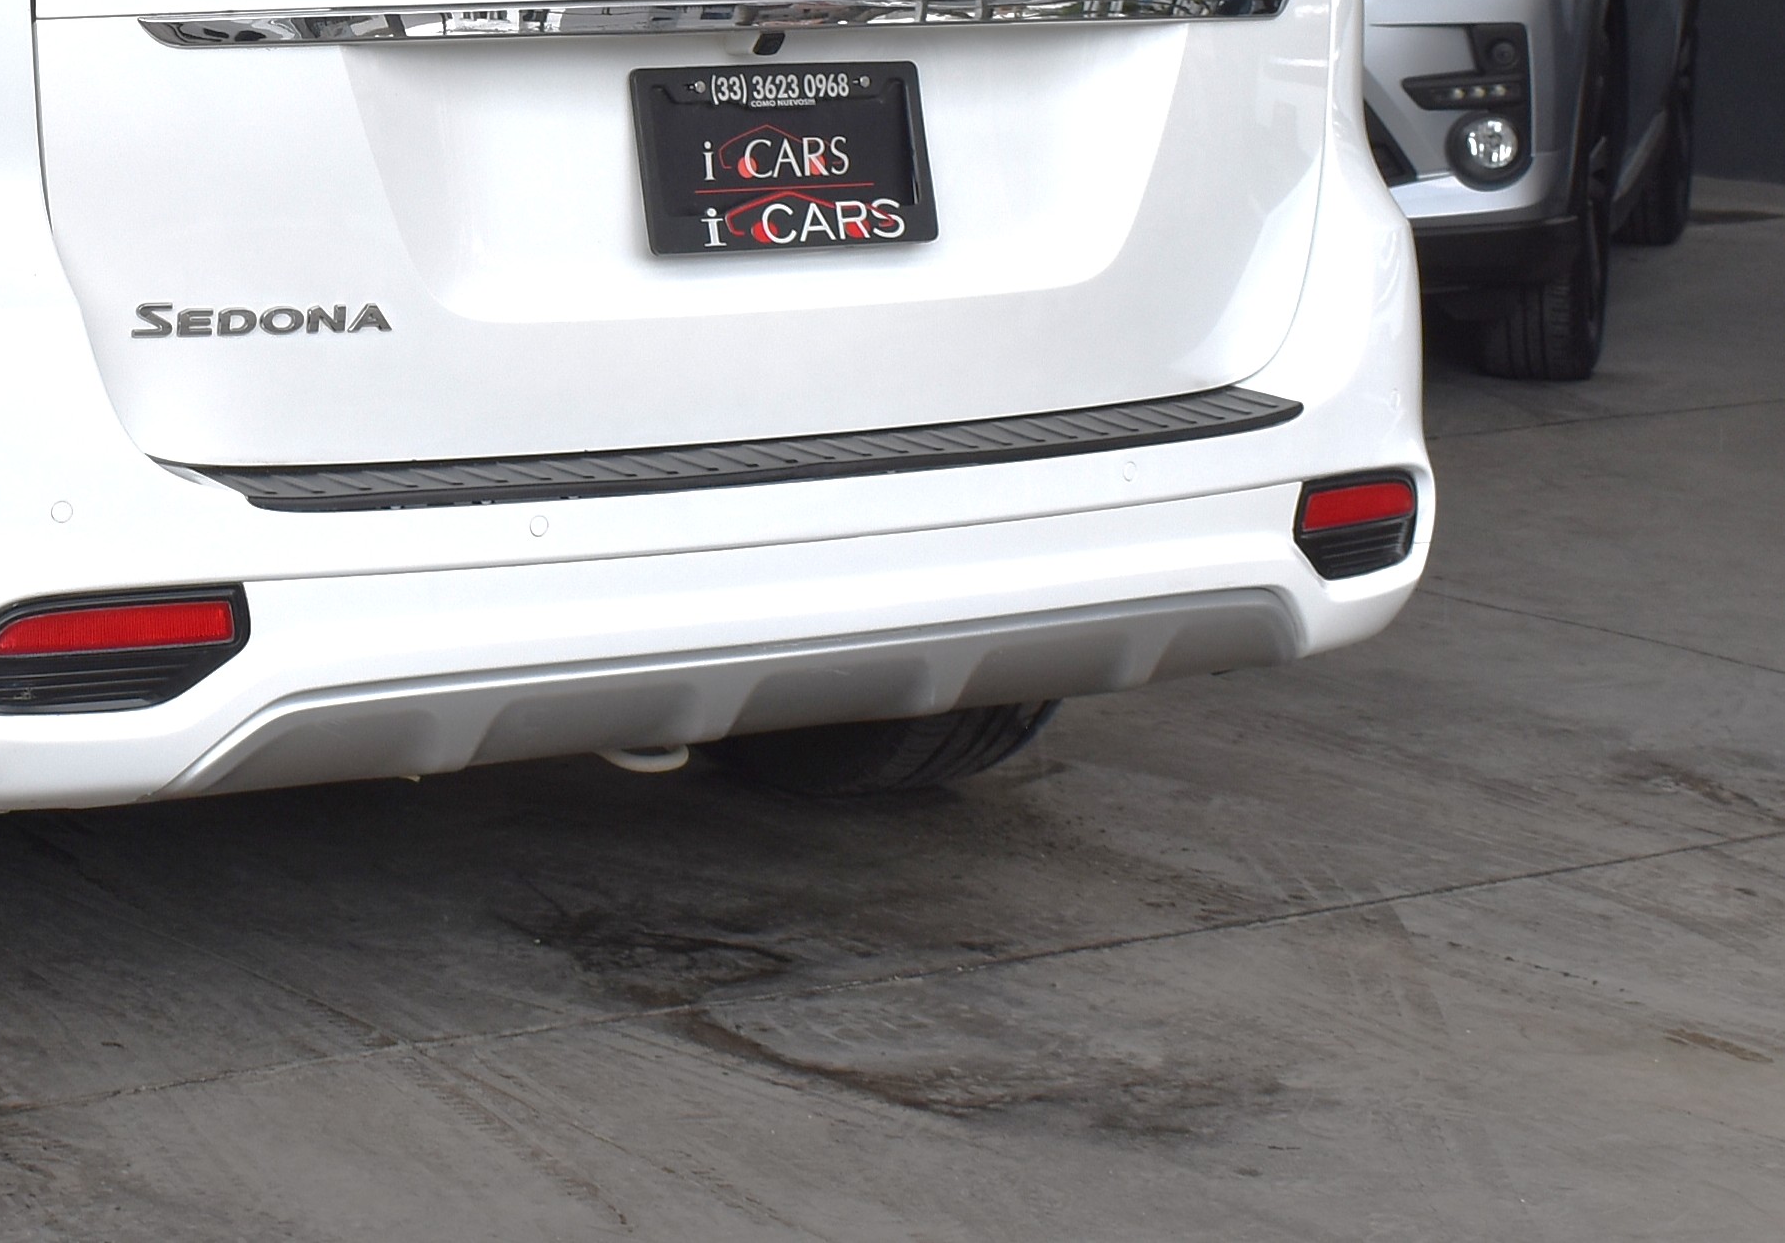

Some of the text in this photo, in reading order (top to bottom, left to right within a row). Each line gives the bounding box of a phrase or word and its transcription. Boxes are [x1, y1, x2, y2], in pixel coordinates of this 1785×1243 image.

[711, 73, 850, 105] (33) 3623 0968
[750, 99, 776, 108] COMO
[743, 135, 851, 179] CARS
[761, 198, 906, 244] CARS
[130, 302, 393, 339] SEDONA
